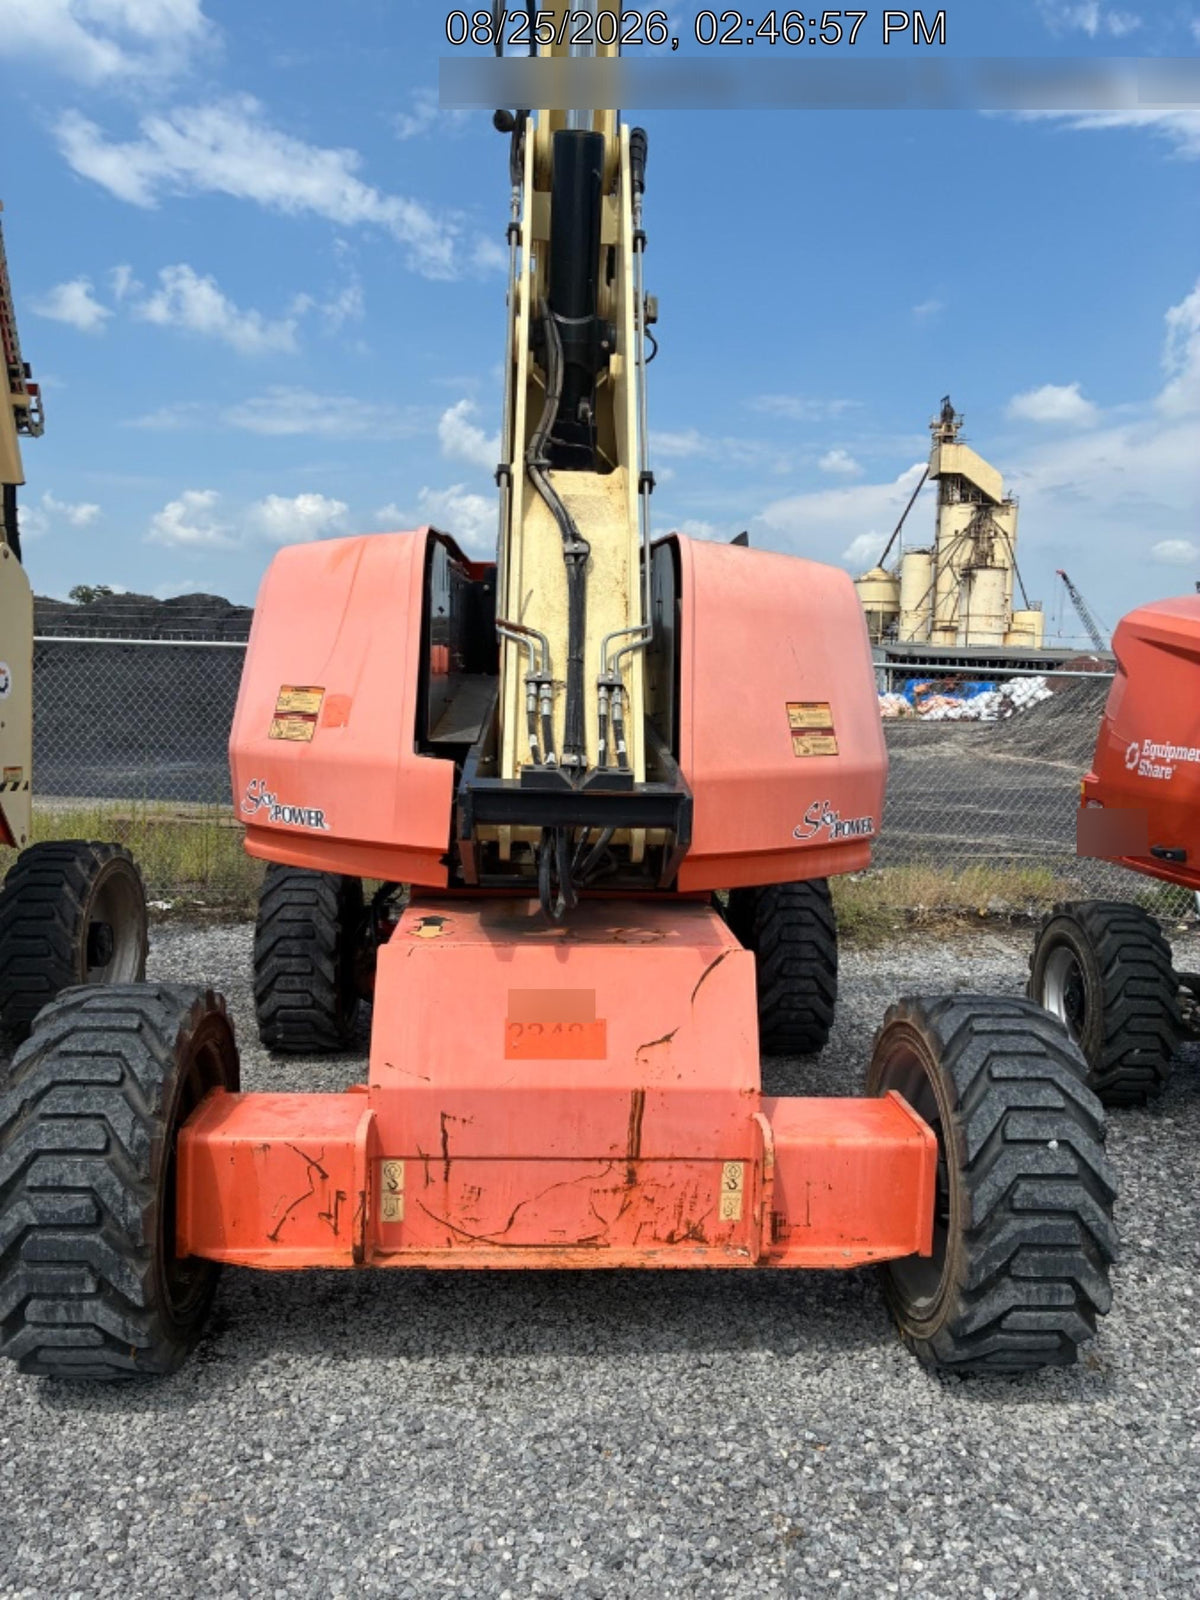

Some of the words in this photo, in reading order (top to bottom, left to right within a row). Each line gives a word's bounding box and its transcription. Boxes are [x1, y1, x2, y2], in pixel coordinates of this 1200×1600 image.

[1138, 760, 1173, 780] Share
[273, 805, 326, 829] POWER
[833, 816, 875, 839] POWER
